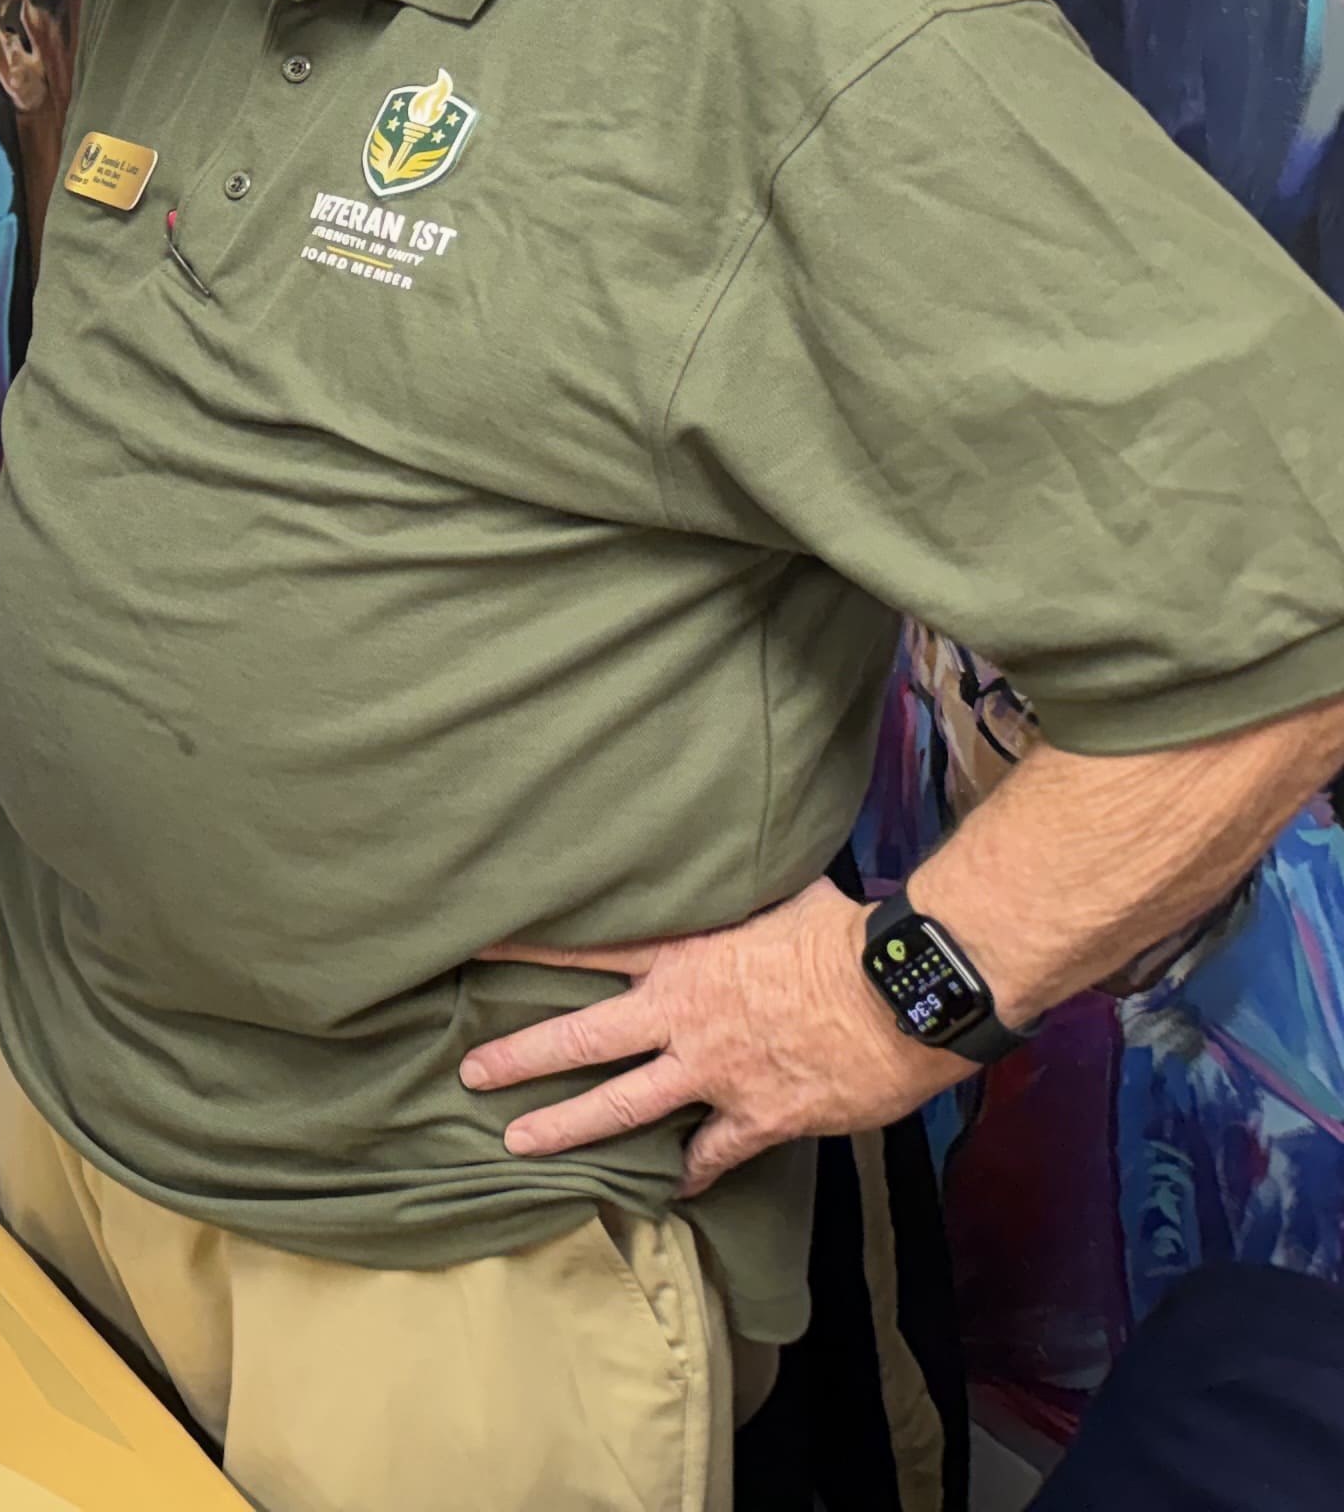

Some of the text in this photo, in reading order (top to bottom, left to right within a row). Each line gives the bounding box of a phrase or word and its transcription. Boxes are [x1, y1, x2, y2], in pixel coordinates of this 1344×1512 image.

[311, 192, 457, 258] VETERAN 1ST
[369, 239, 387, 256] IN
[387, 246, 426, 267] UNITY
[350, 261, 414, 291] MEMBER
